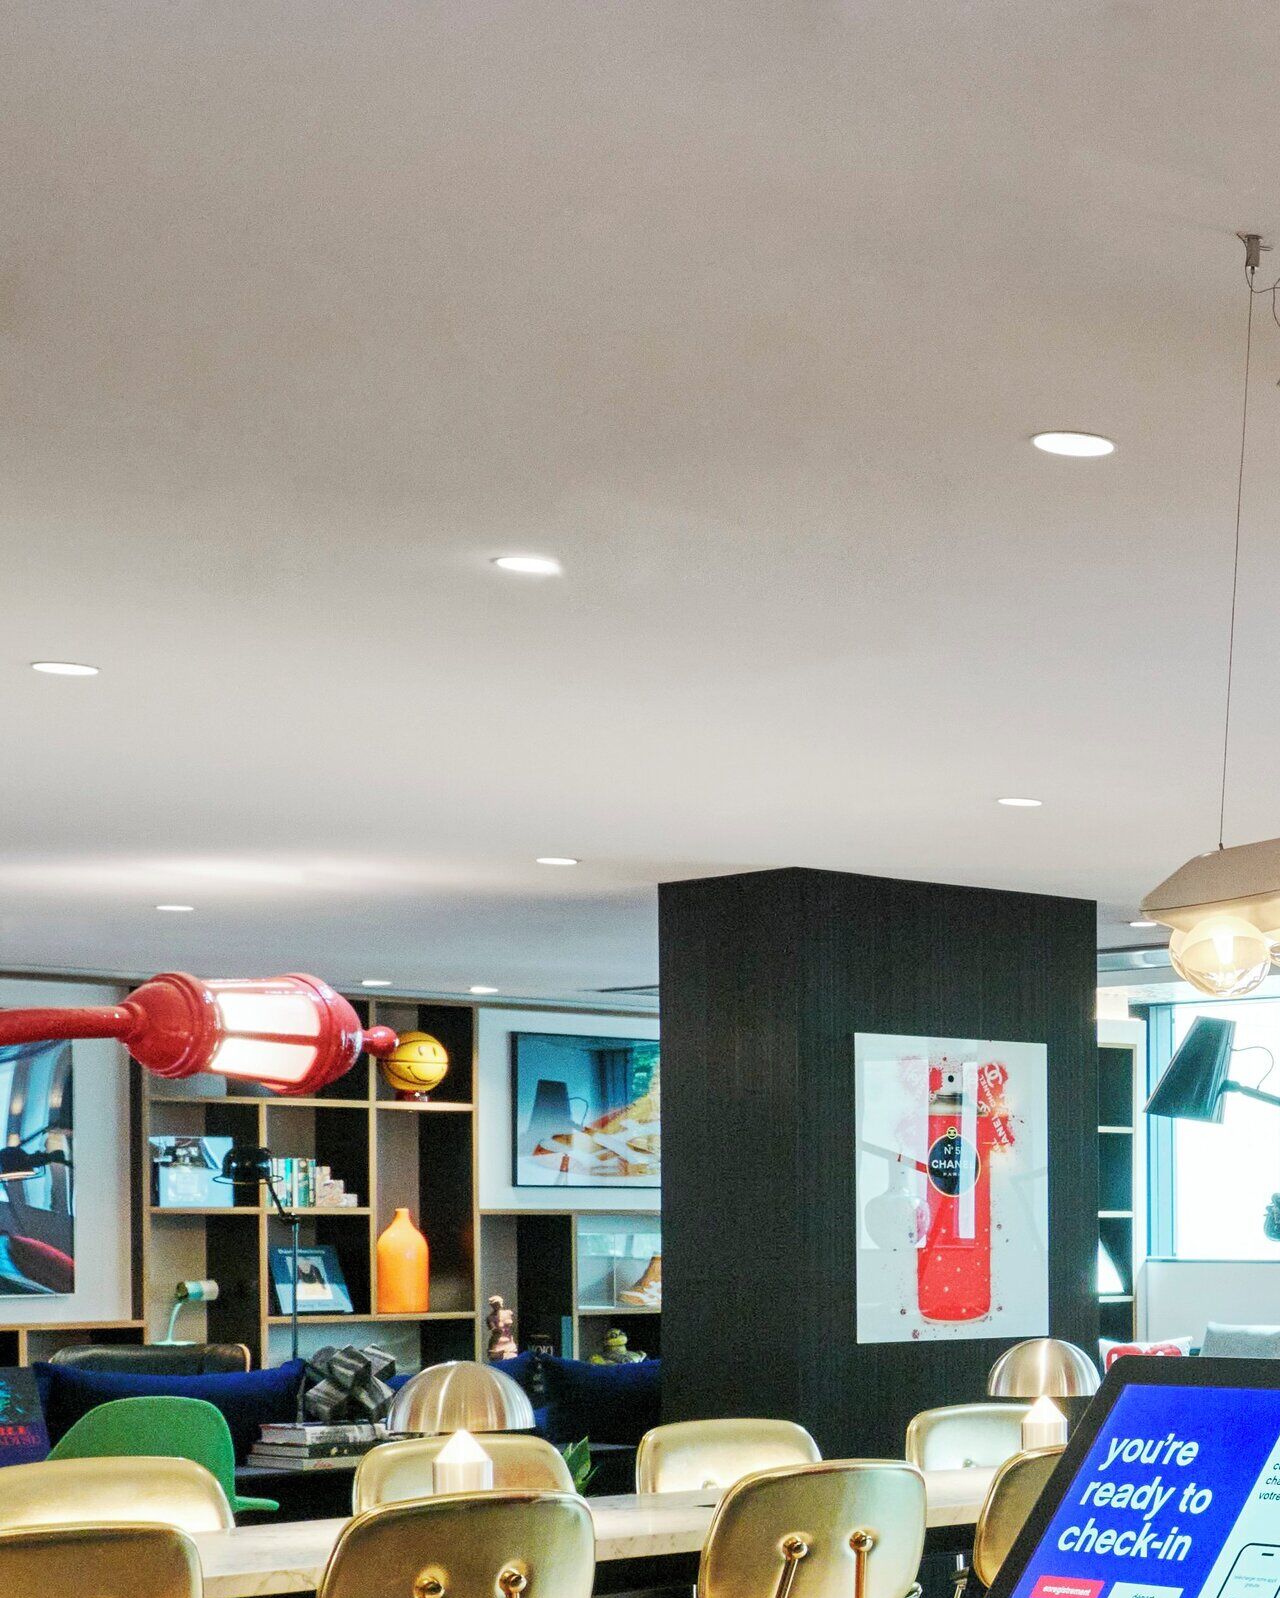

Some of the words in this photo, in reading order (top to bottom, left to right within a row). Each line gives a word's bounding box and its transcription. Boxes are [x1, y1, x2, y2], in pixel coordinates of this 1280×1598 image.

[1098, 1433, 1200, 1471] you're
[1079, 1476, 1176, 1521] ready
[1178, 1482, 1213, 1515] to
[1057, 1518, 1192, 1561] check-in
